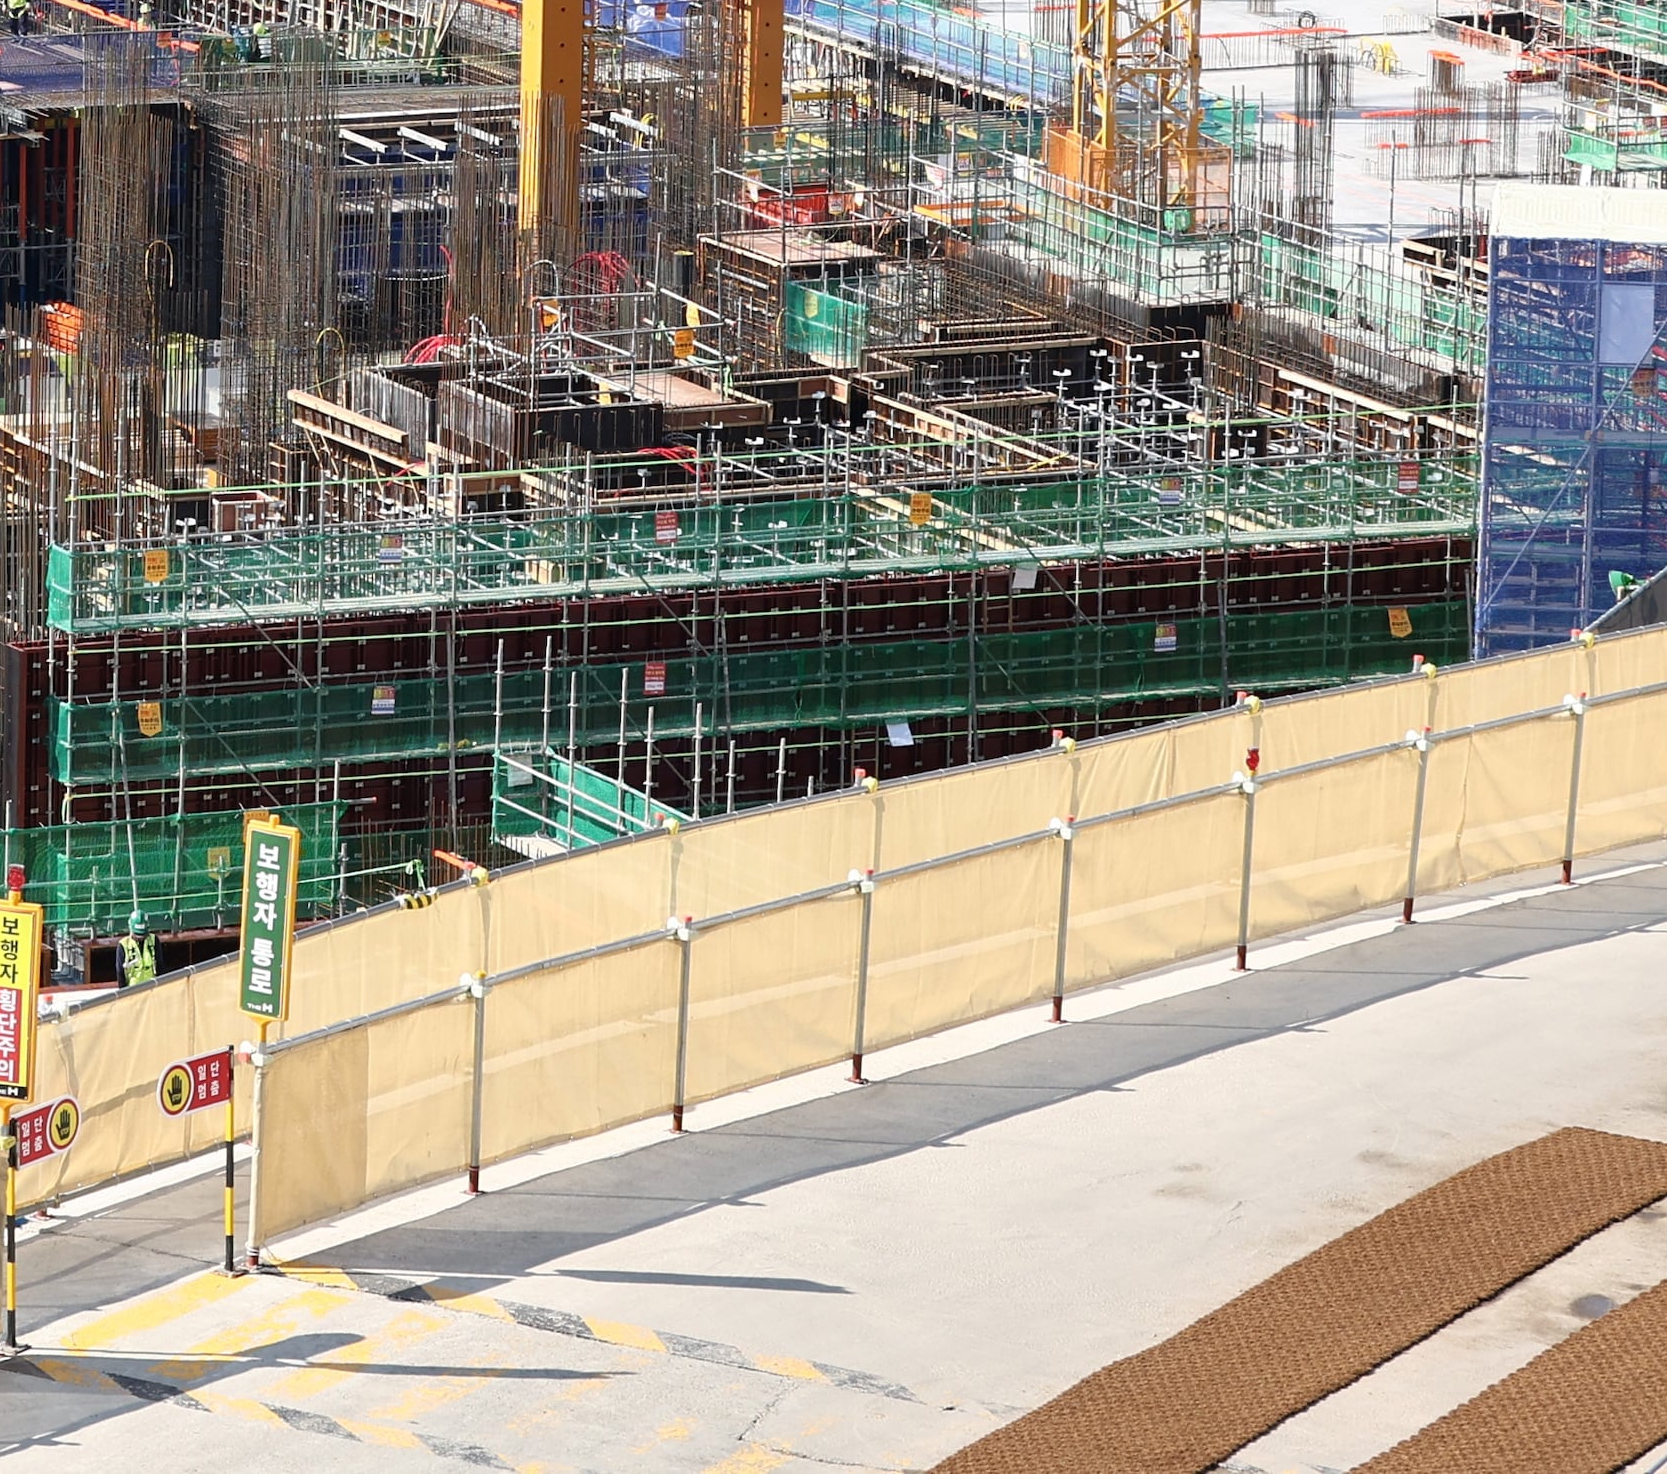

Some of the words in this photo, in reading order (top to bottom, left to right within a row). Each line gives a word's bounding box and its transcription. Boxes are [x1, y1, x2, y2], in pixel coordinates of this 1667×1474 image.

[253, 843, 281, 931] 보행자
[0, 916, 20, 984] 보행자
[248, 937, 275, 995] 통로
[197, 1060, 220, 1082] 일단
[7, 1086, 19, 1096] H
[197, 1080, 220, 1100] 멈춤
[22, 1116, 44, 1138] 일단
[22, 1134, 43, 1157] 멈춤
